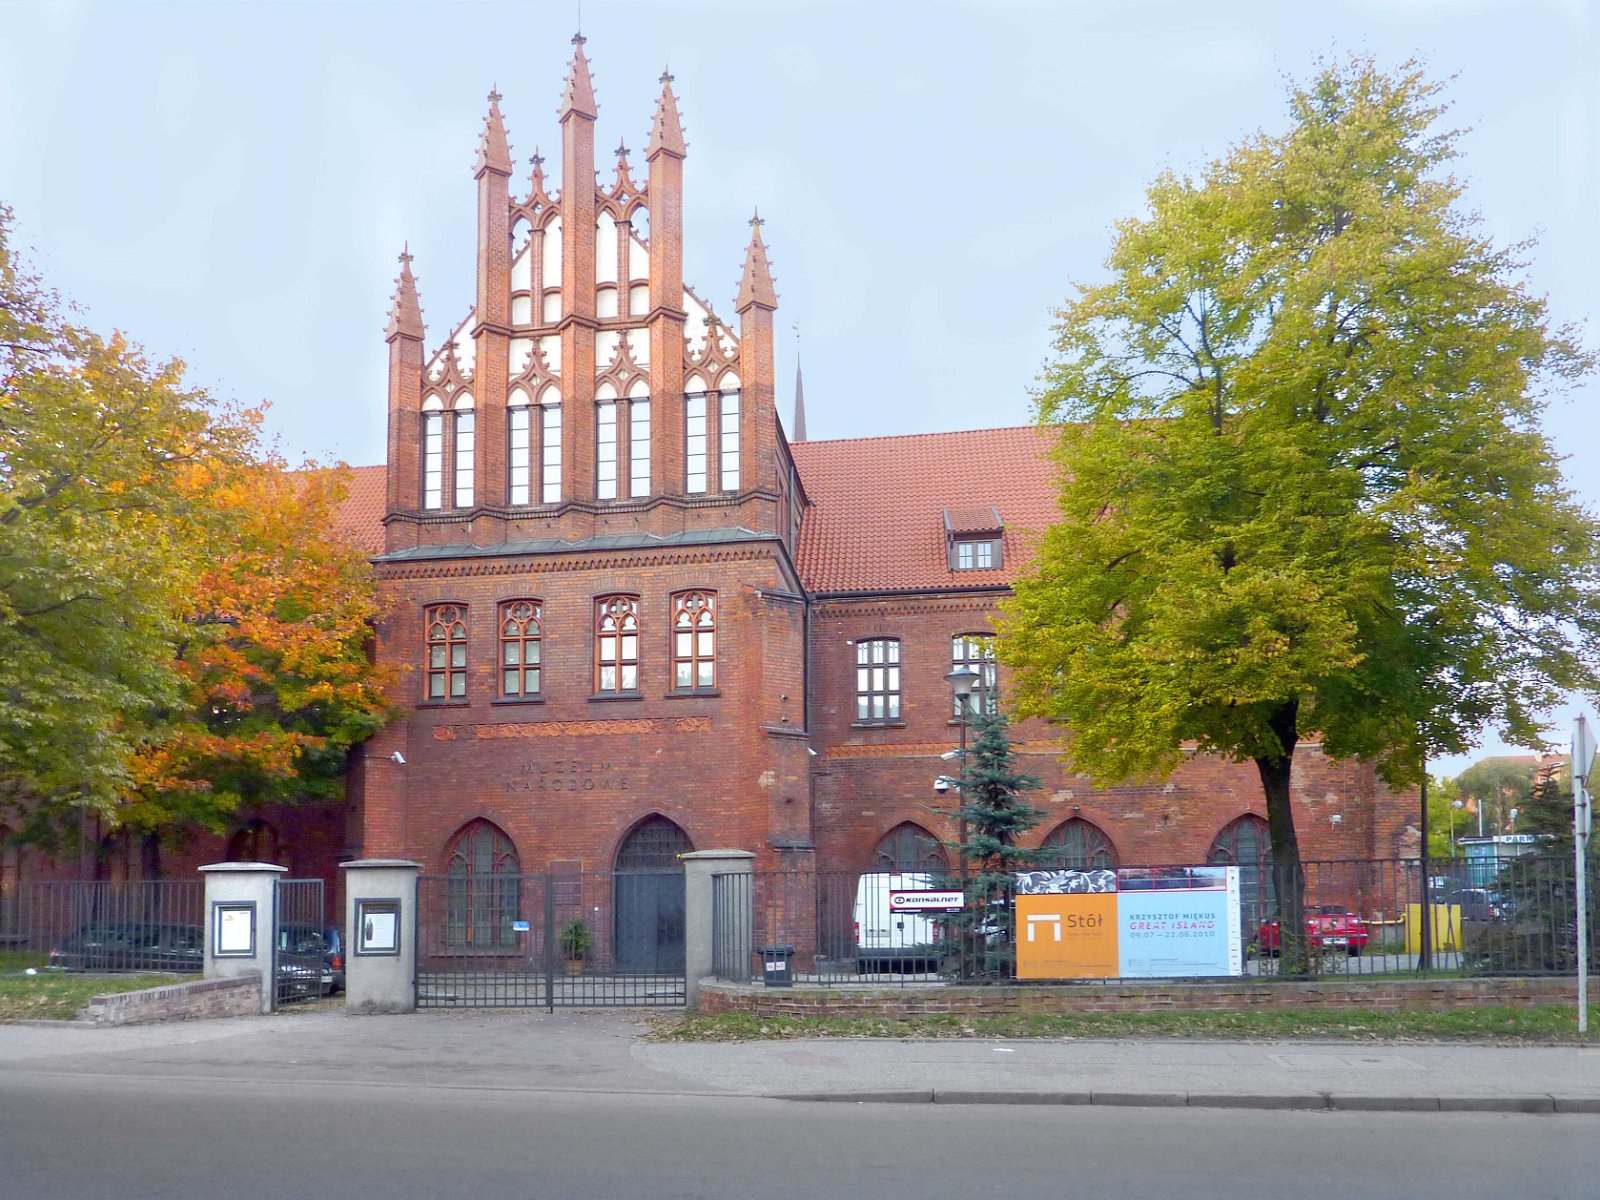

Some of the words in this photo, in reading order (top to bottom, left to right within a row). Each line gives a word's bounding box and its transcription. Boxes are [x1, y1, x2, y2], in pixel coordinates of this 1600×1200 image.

[505, 778, 628, 792] NARODOWE
[1067, 913, 1103, 928] Stół
[1129, 922, 1166, 930] GREAT
[1171, 920, 1215, 929] ISLAND
